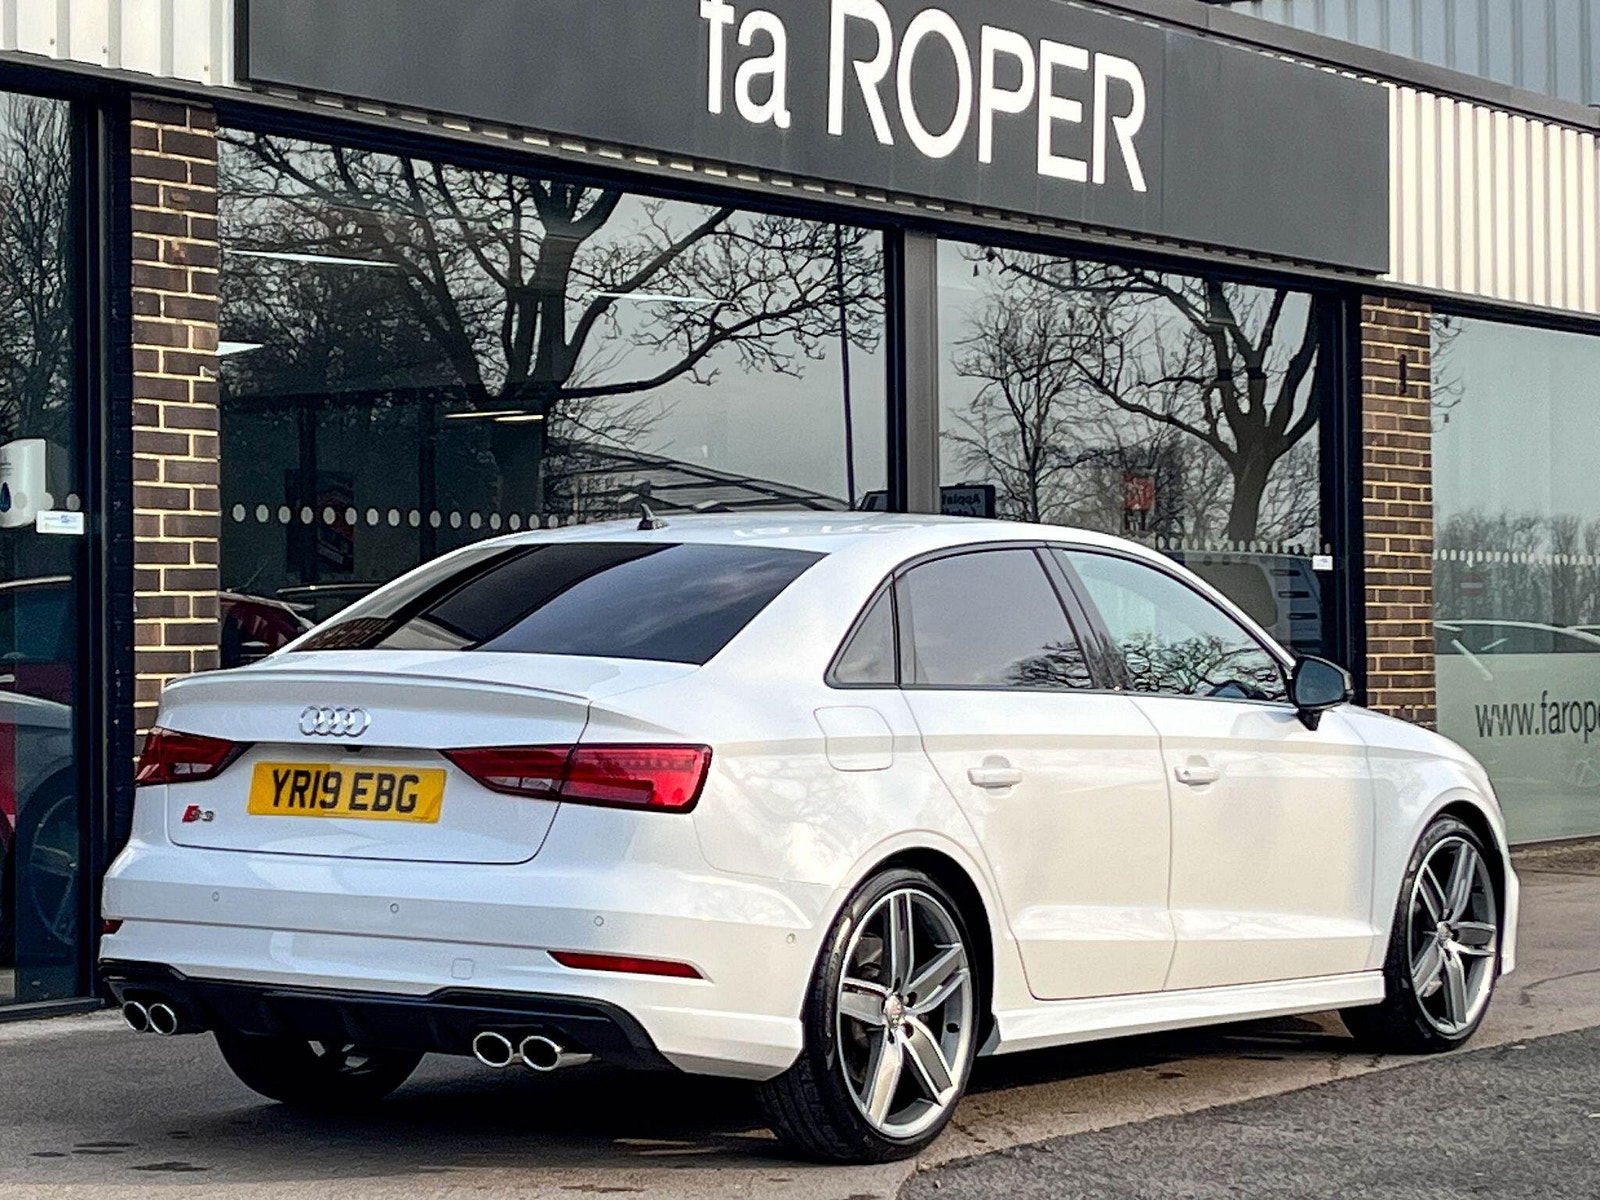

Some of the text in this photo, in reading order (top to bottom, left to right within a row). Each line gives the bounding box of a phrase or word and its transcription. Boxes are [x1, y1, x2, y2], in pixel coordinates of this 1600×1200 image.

[700, 0, 1148, 193] fa ROPER
[1475, 690, 1600, 744] www.farop
[182, 804, 215, 823] S3
[271, 768, 420, 814] YR19 EBG
